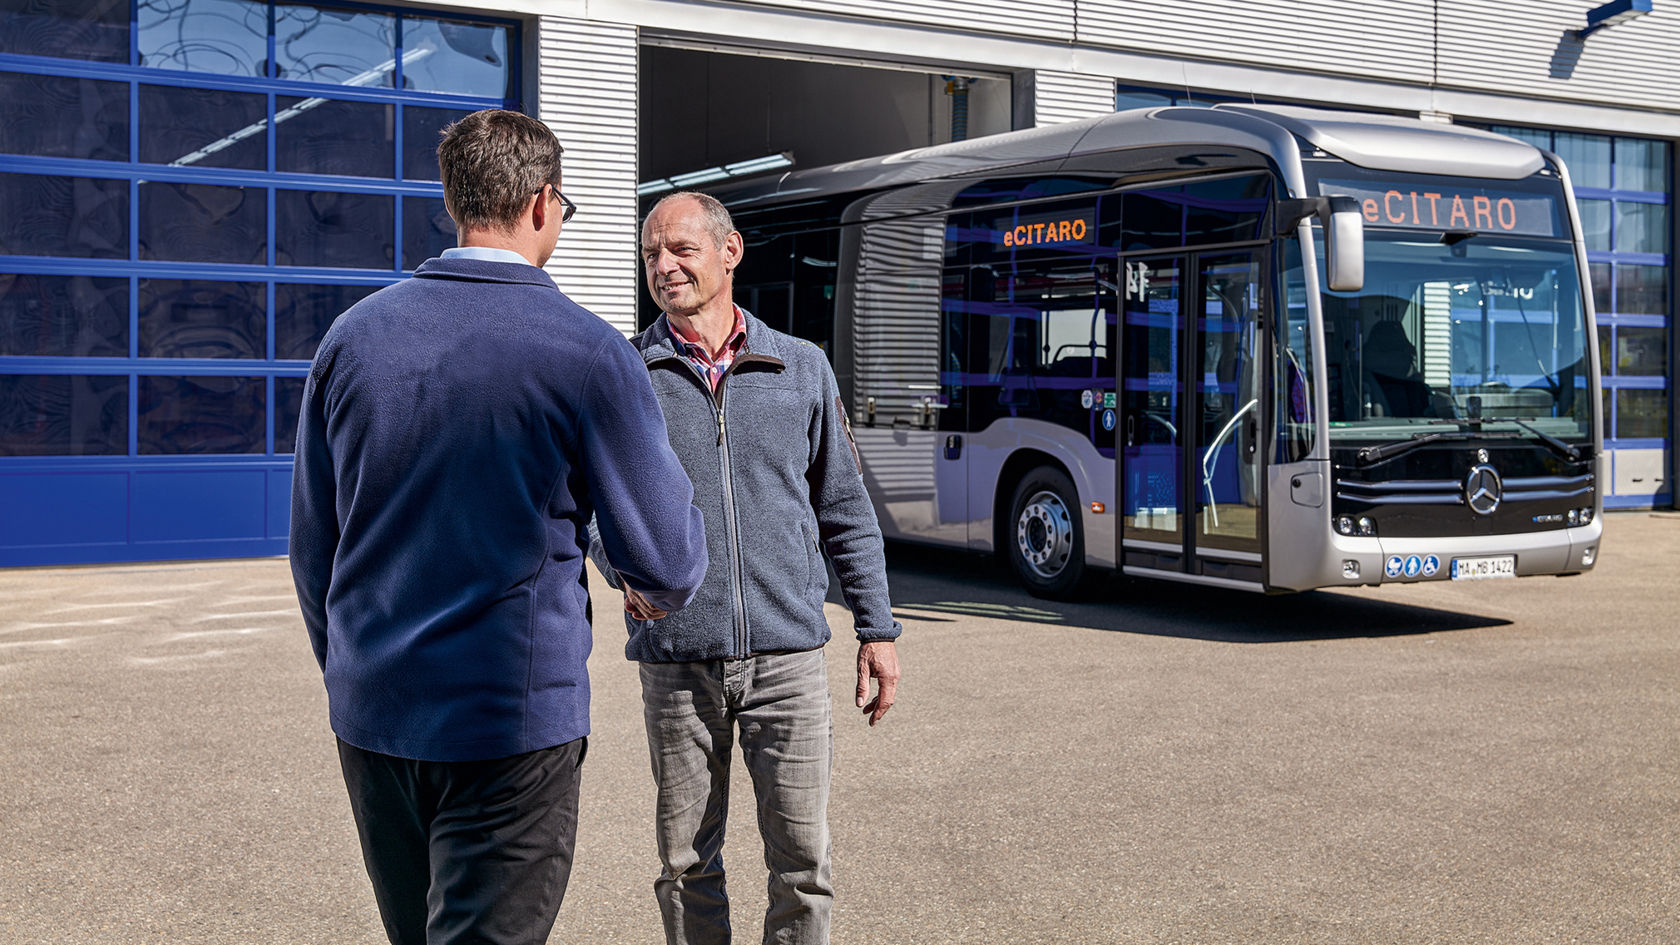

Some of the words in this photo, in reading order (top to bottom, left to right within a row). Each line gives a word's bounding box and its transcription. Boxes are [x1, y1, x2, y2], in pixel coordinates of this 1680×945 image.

[1362, 190, 1516, 230] eCITARO
[1003, 219, 1086, 247] eCITARO
[1490, 560, 1513, 574] 1422
